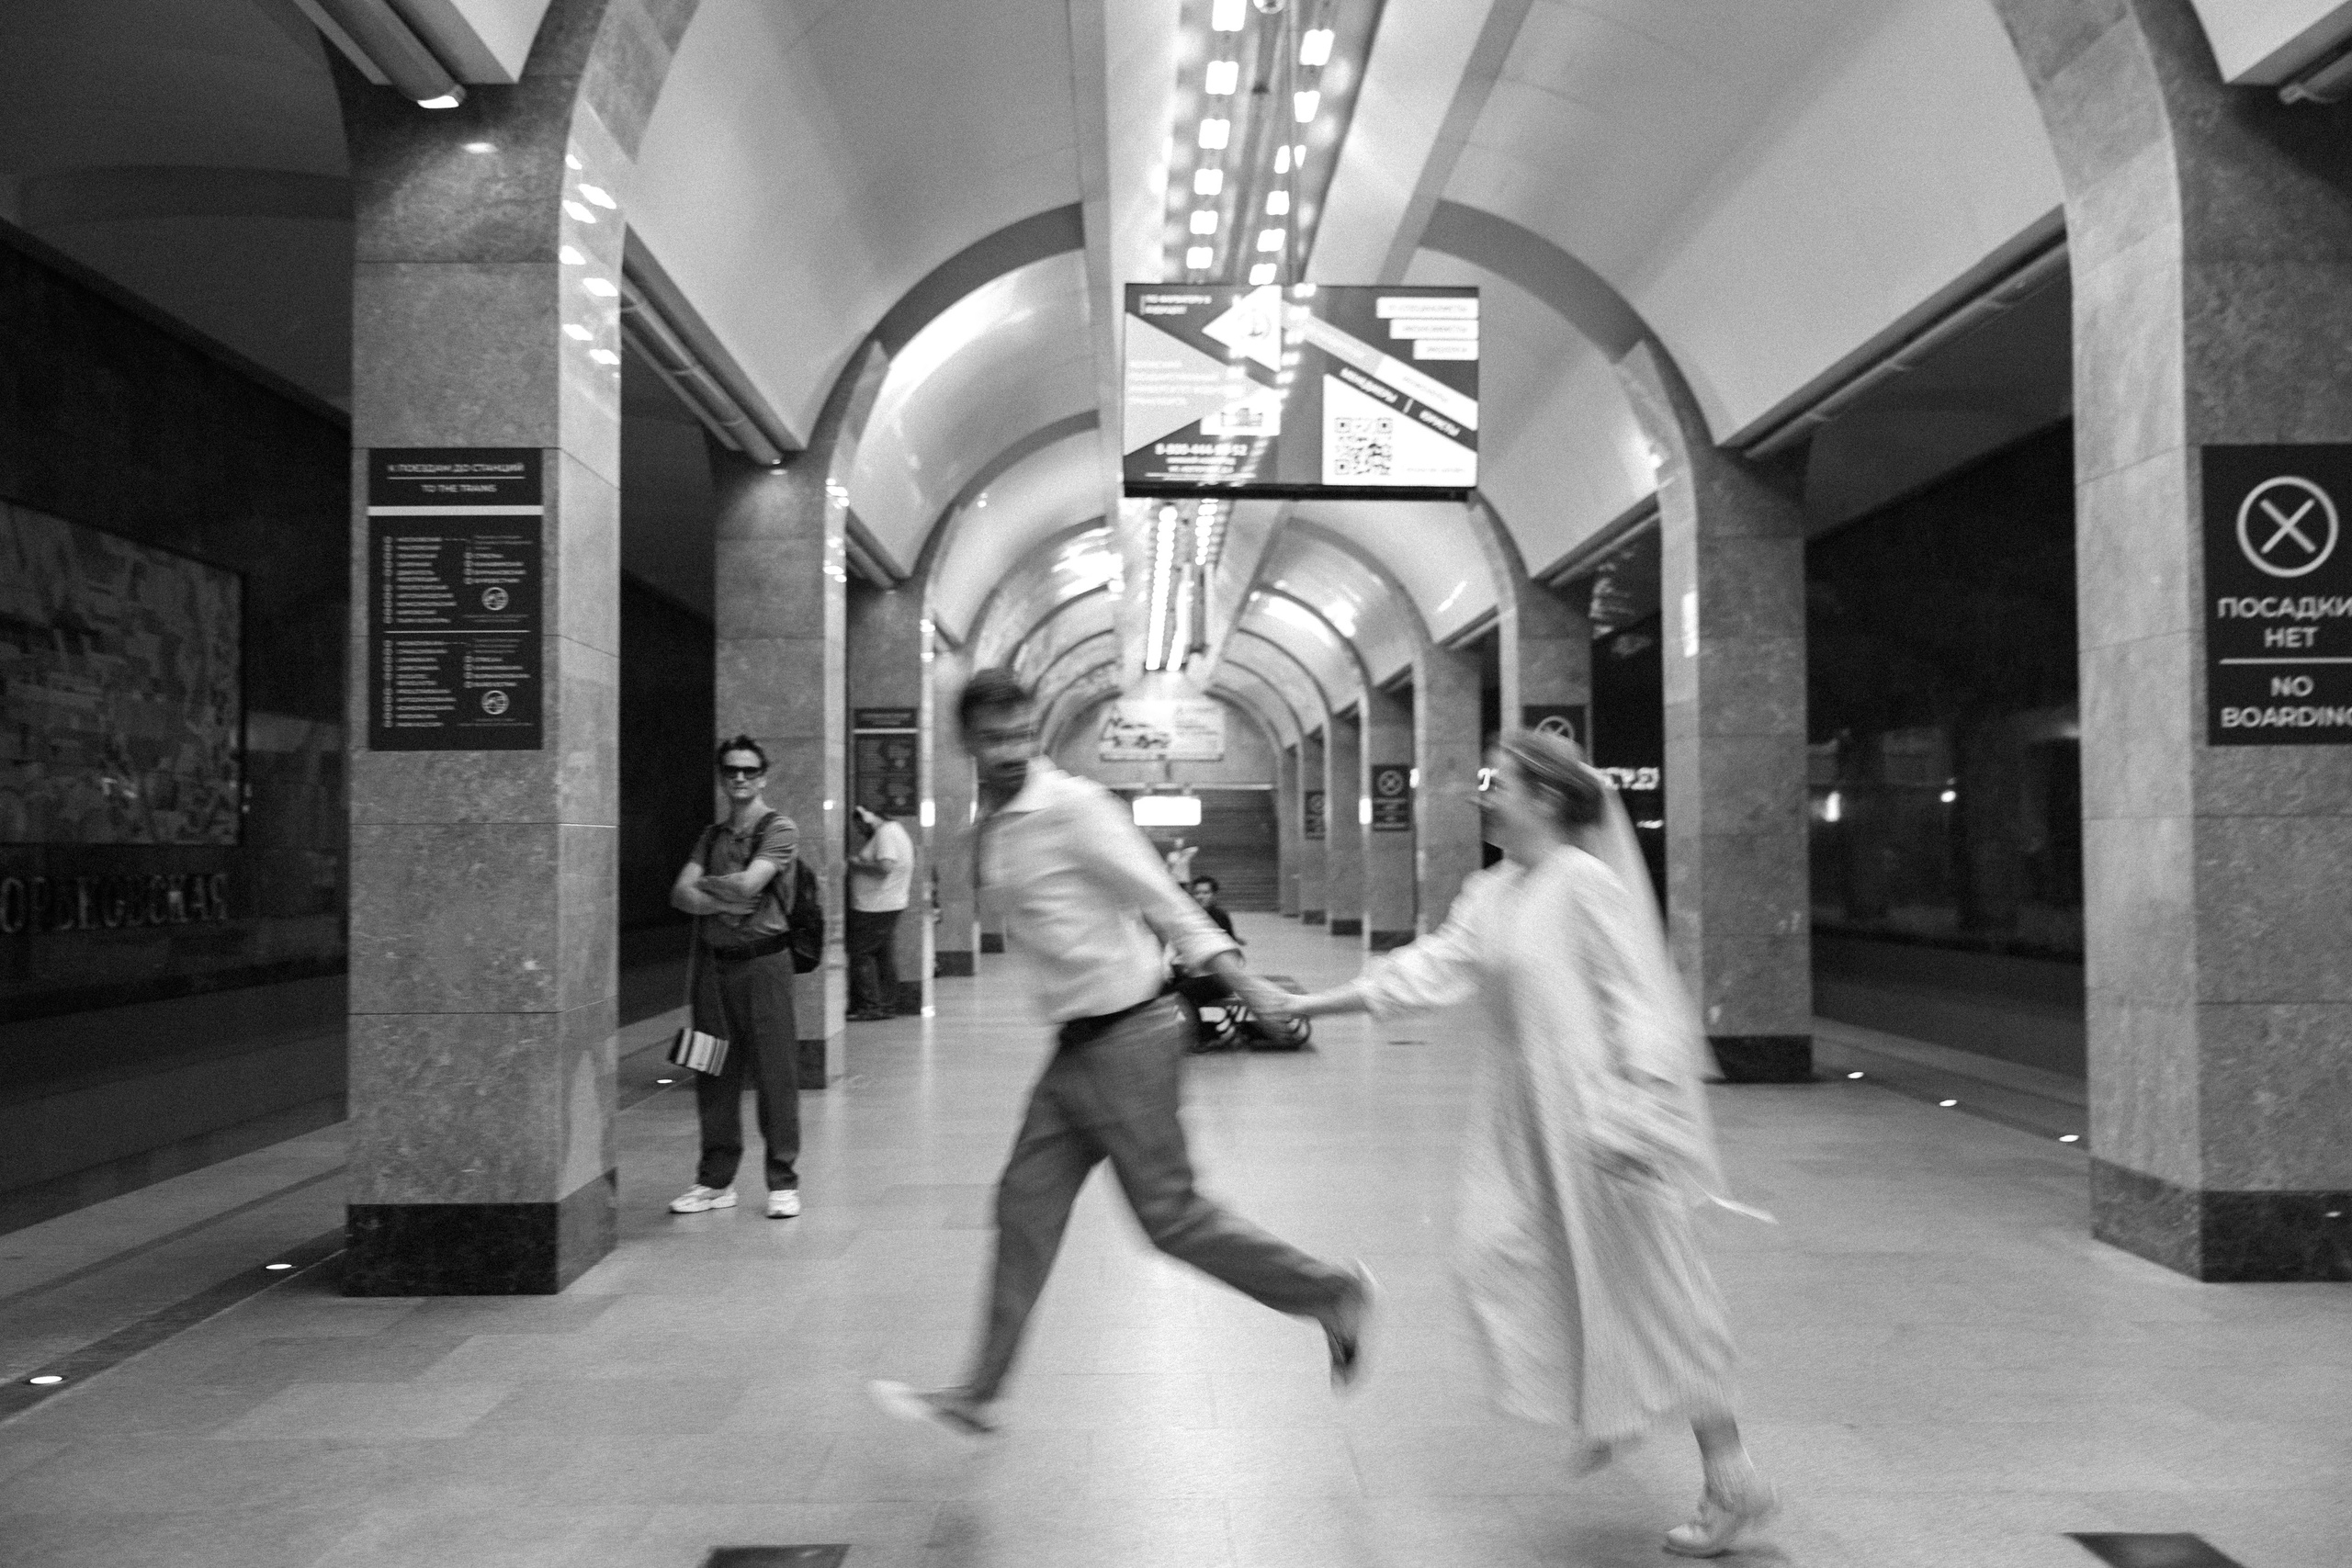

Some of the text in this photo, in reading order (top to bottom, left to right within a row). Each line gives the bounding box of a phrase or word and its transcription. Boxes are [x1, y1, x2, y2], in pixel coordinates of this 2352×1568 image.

[398, 463, 452, 472] ПОЕЗДАМ
[452, 463, 470, 473] ДО
[421, 484, 498, 492] TO THE TRAINS
[2217, 596, 2352, 621] ПОСАДКИ
[2264, 626, 2319, 649] НЕТ
[2270, 675, 2314, 697] NO
